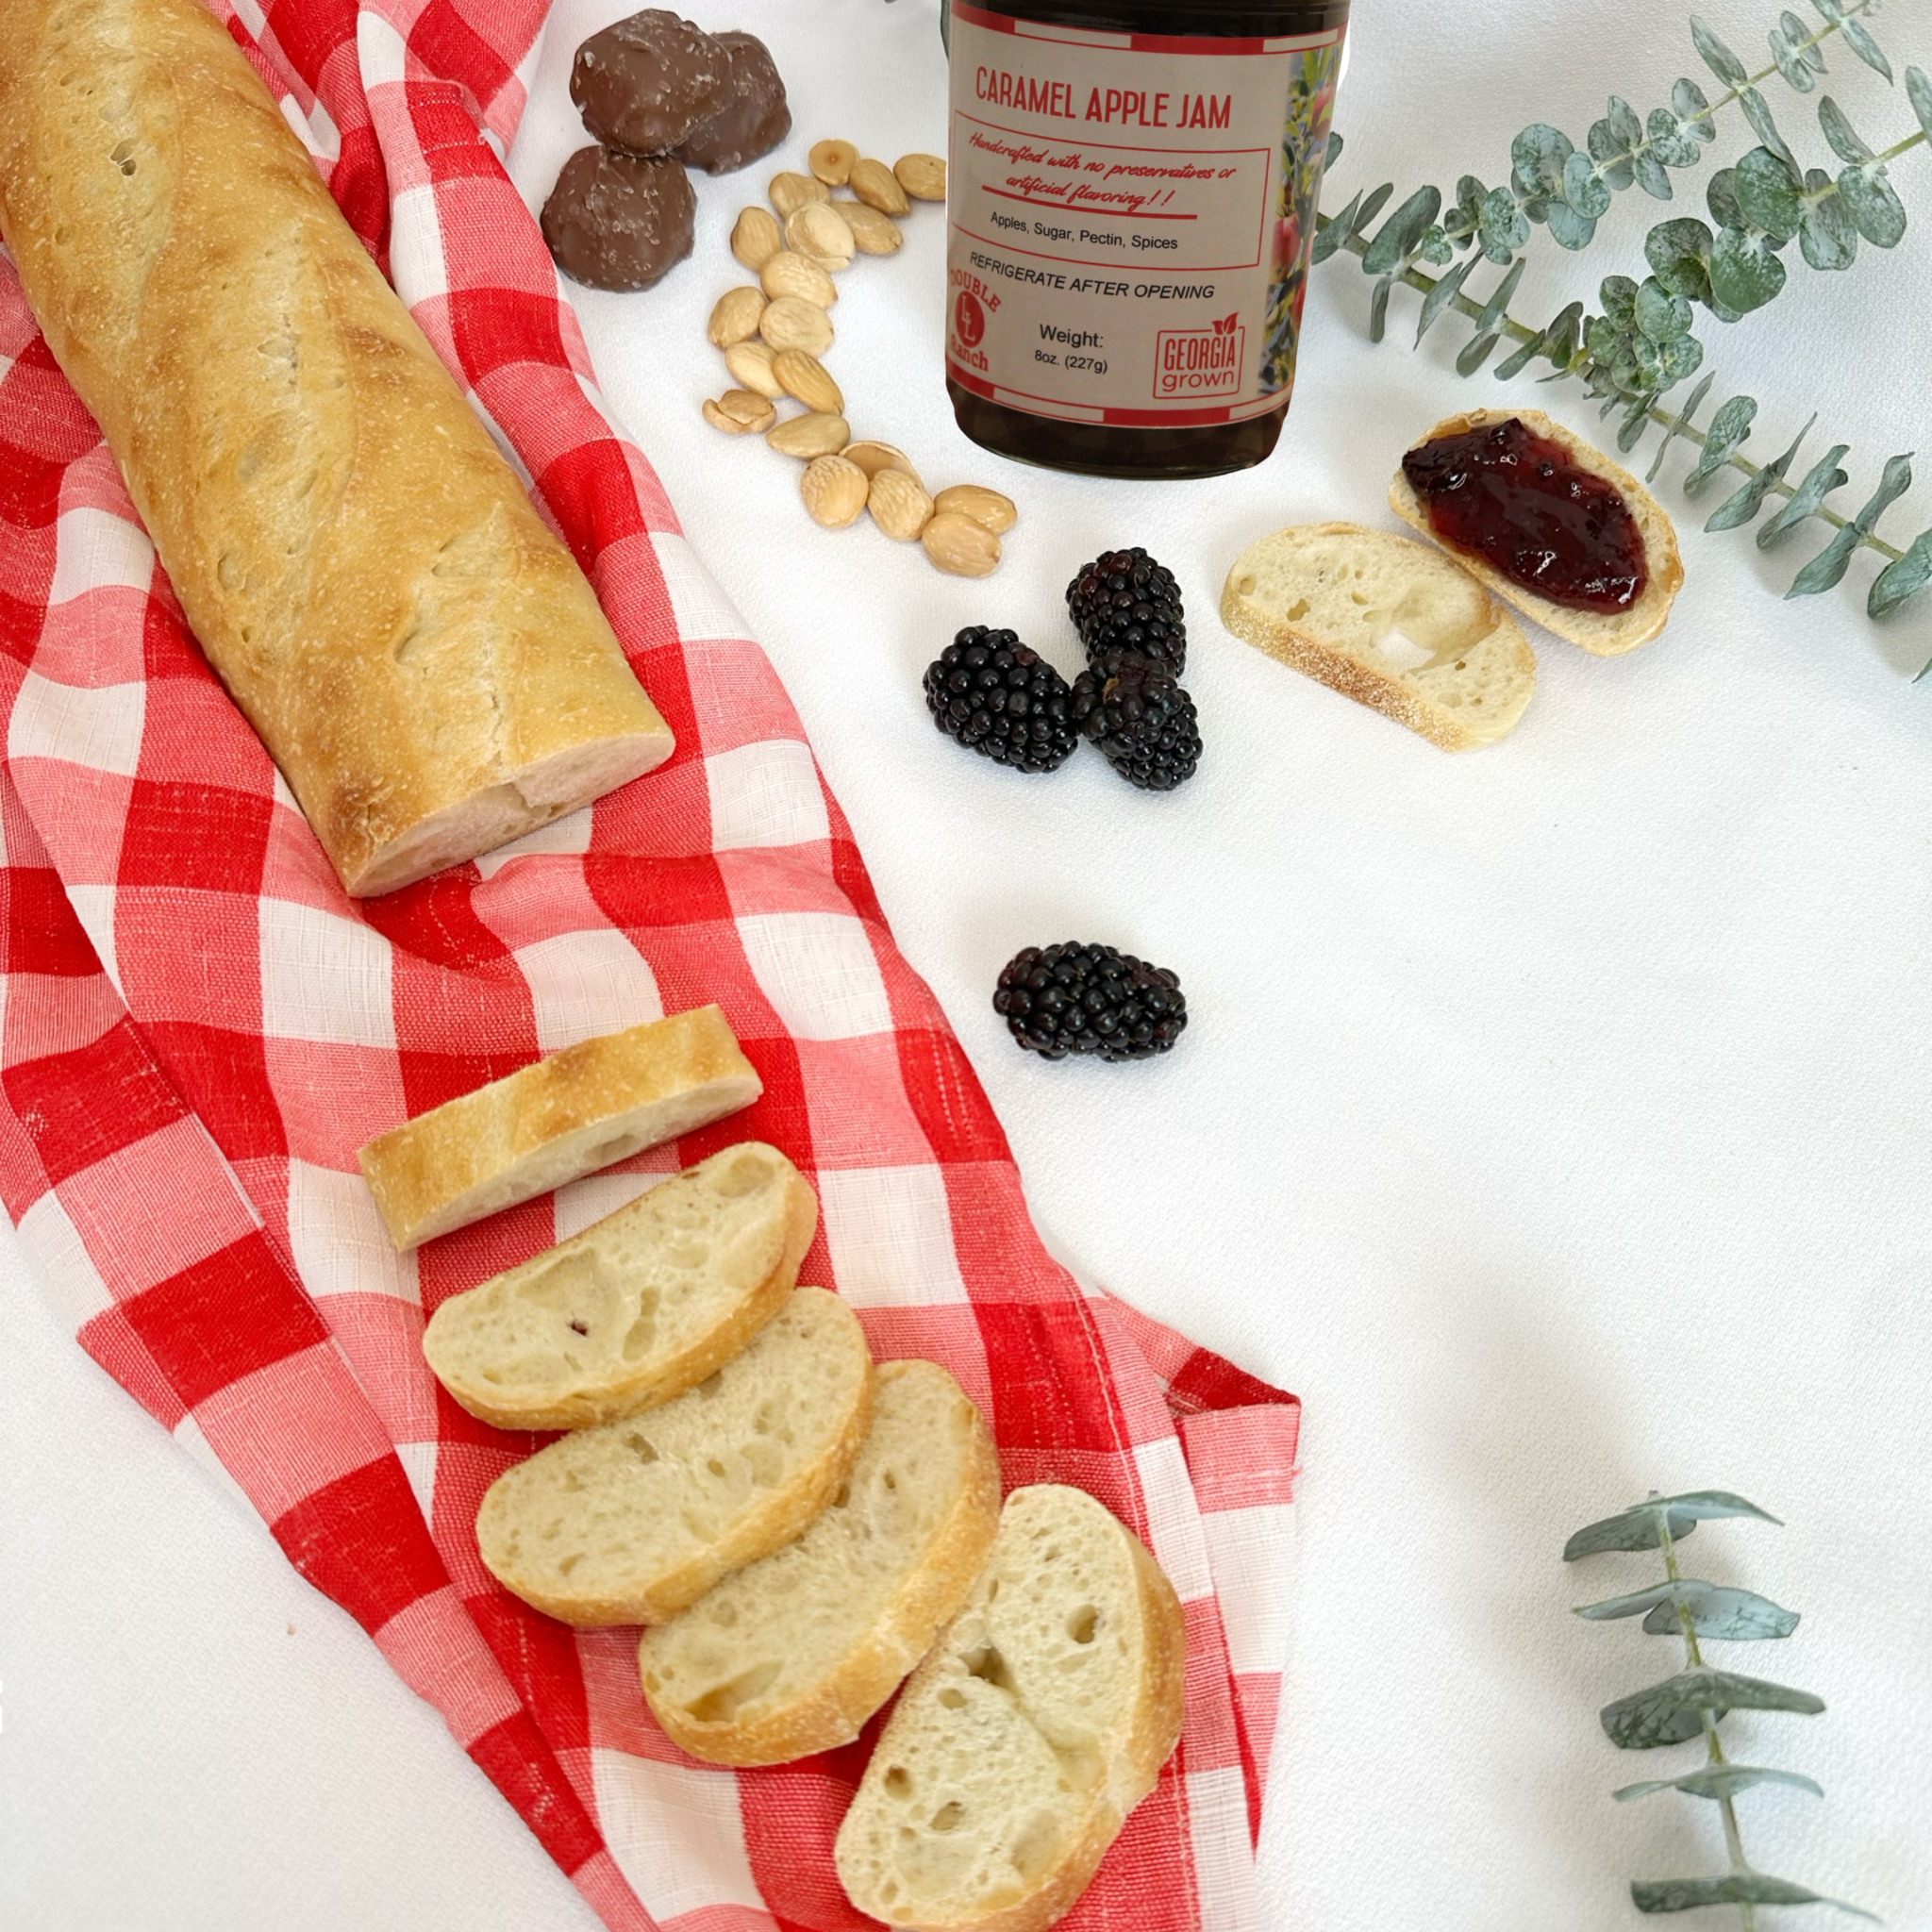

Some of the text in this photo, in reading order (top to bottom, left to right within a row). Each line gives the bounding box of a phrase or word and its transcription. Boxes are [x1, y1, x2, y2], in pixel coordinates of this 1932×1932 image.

[976, 66, 1231, 128] CARAMEL APPLE JAM
[968, 132, 1236, 180] Handcrafted with no preservatives or
[1006, 174, 1069, 196] artificial
[991, 211, 1178, 249] Apples, Sugar, Pectin, Spices
[949, 268, 1002, 313] DOUBLE
[970, 252, 1214, 299] REFRIGERATE AFTER OPENING
[950, 333, 989, 372] Ranch
[1040, 324, 1104, 349] Weight:
[1163, 337, 1236, 371] GEORGIA
[1035, 350, 1108, 374] 8oz. (227g)
[1162, 371, 1234, 392] grown
